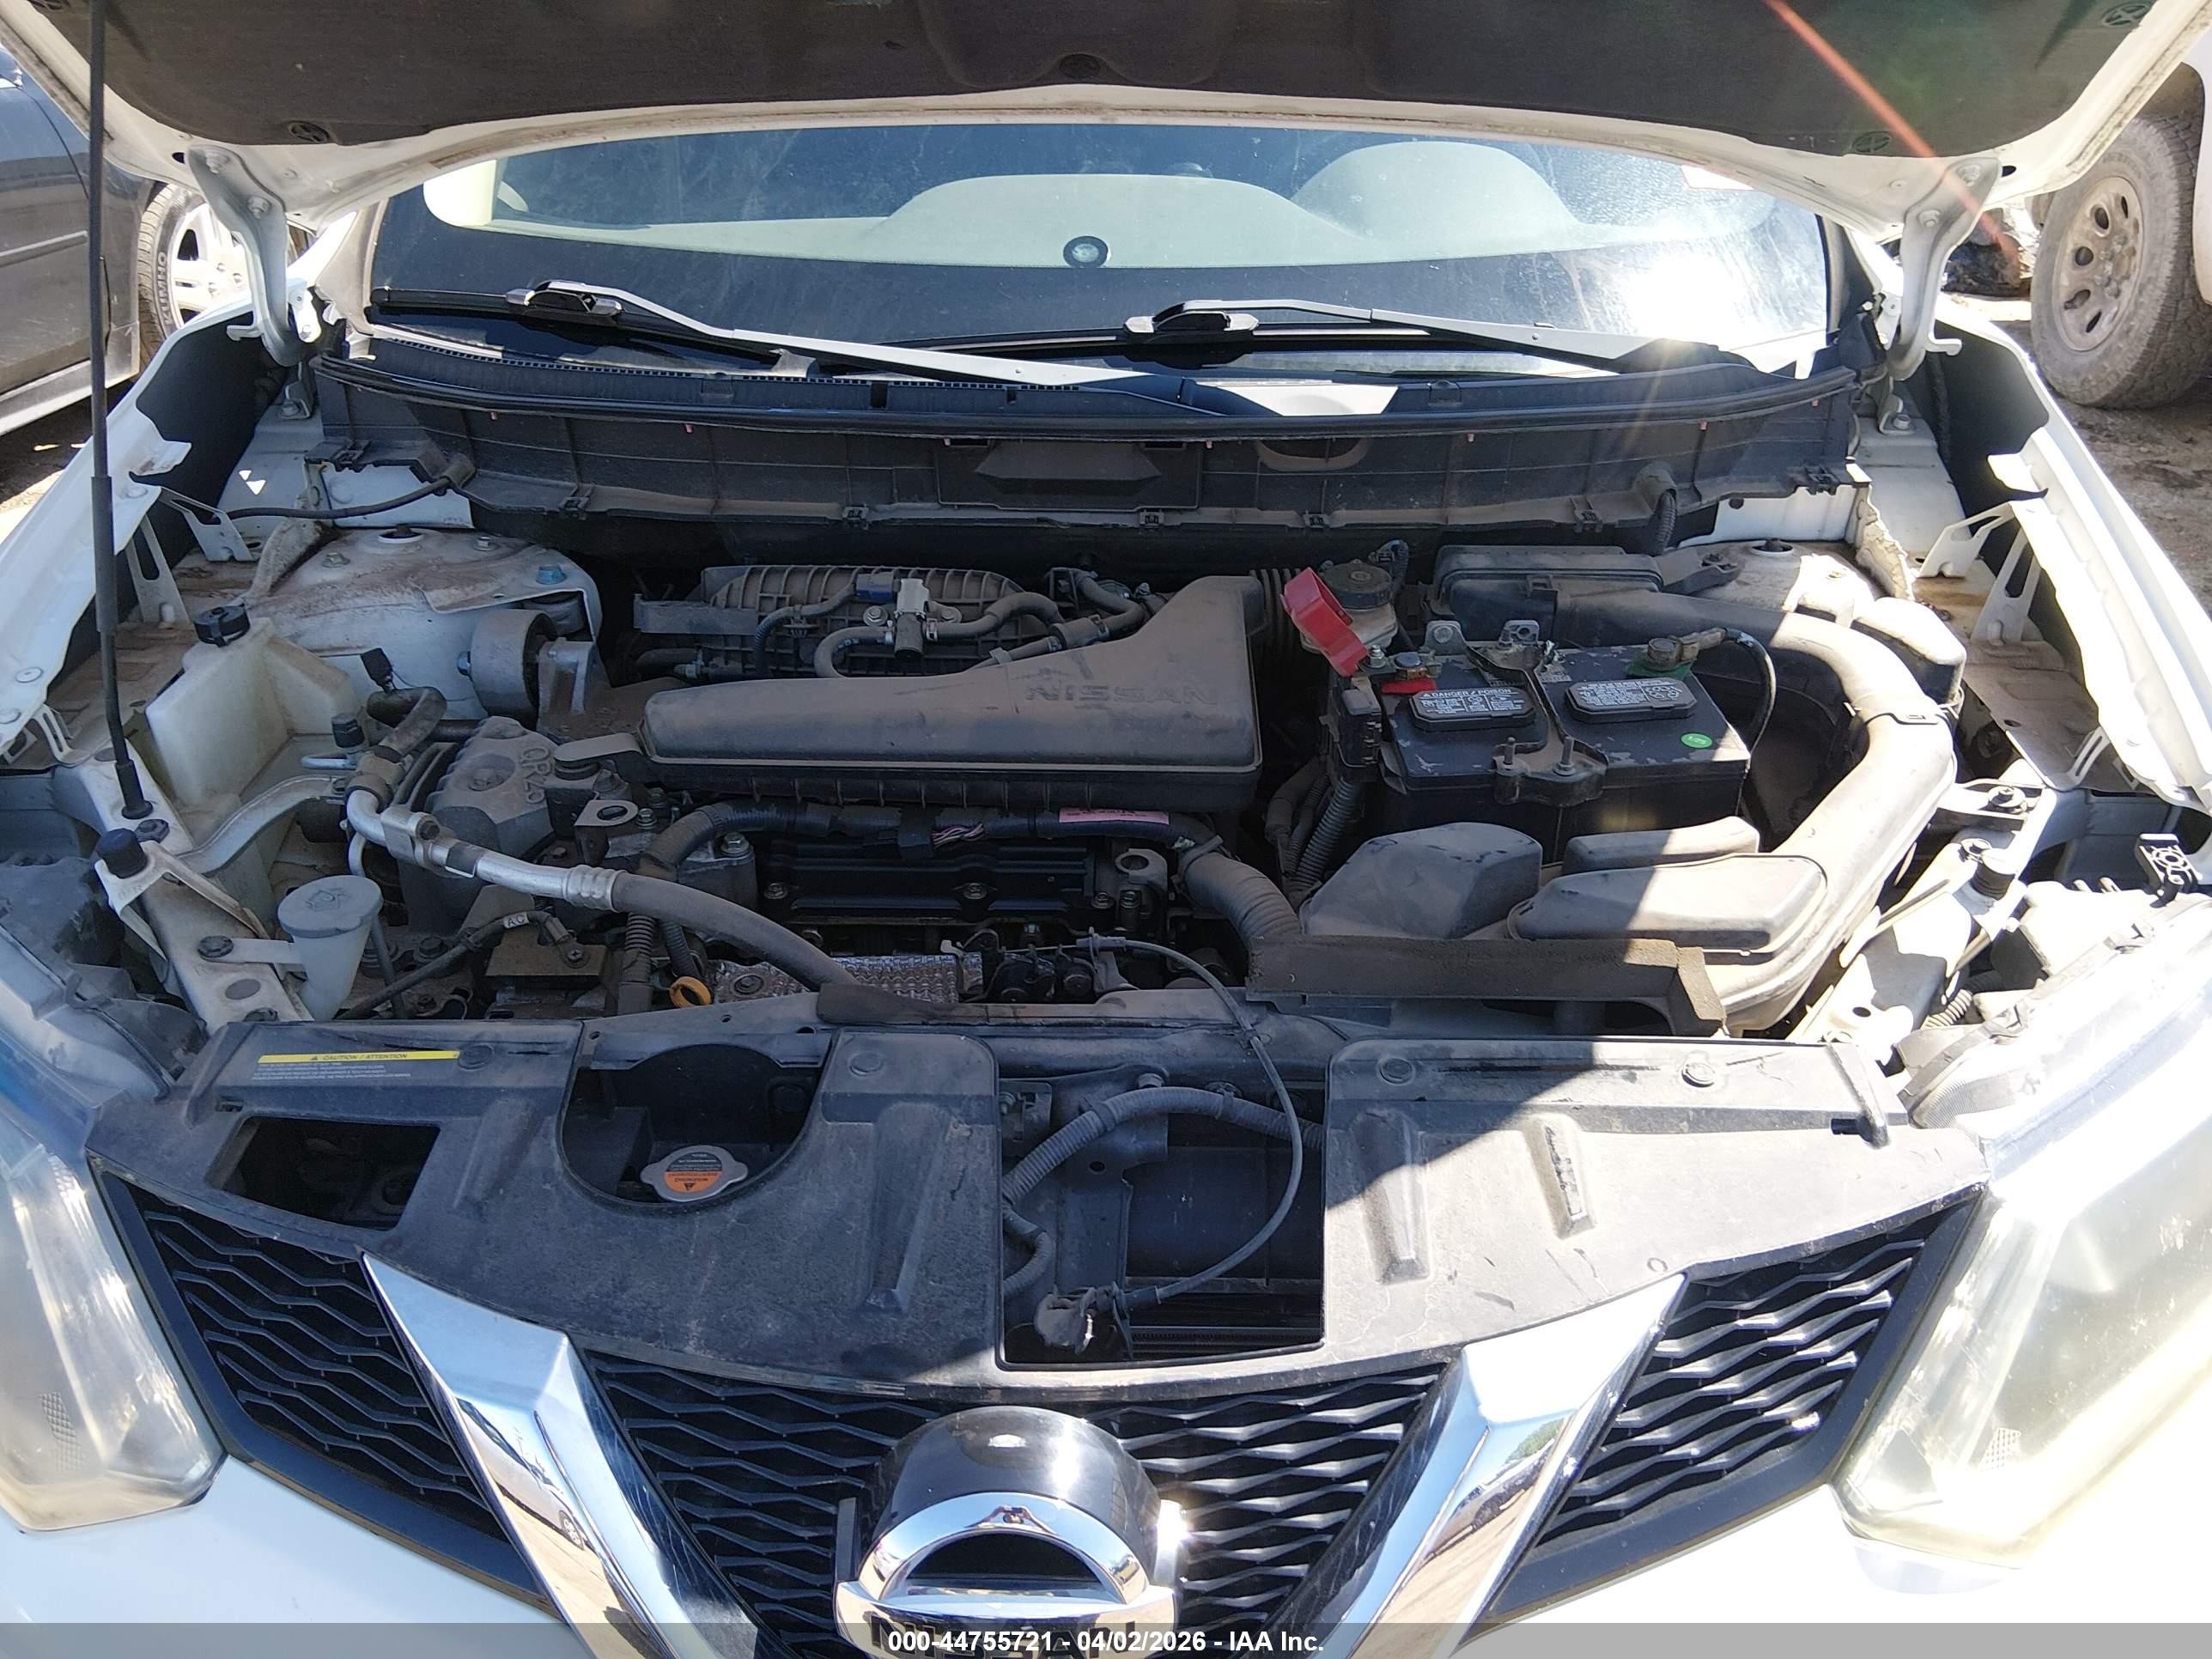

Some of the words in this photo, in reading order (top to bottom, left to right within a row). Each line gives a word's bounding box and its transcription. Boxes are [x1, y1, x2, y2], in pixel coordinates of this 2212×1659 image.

[157, 252, 173, 325] KUMHO
[1024, 684, 1218, 705] NISSAN
[1431, 690, 1469, 698] DANGER
